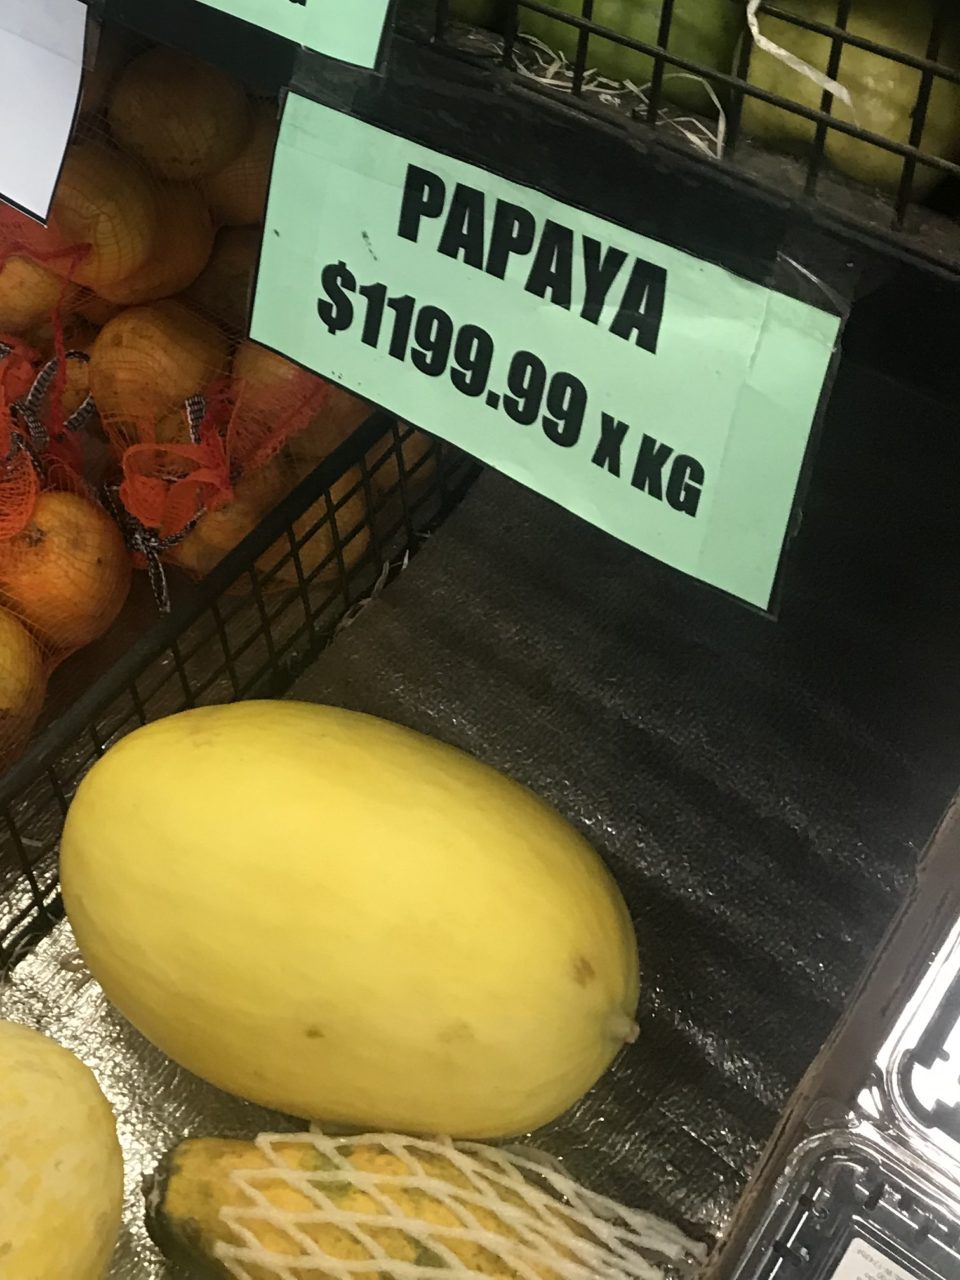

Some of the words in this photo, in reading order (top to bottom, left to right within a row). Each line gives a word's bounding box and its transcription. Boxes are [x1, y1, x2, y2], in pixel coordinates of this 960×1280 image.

[397, 162, 667, 355] PAPAYA
[317, 260, 588, 448] $1199.99
[591, 411, 629, 477] X
[631, 433, 705, 518] KG
